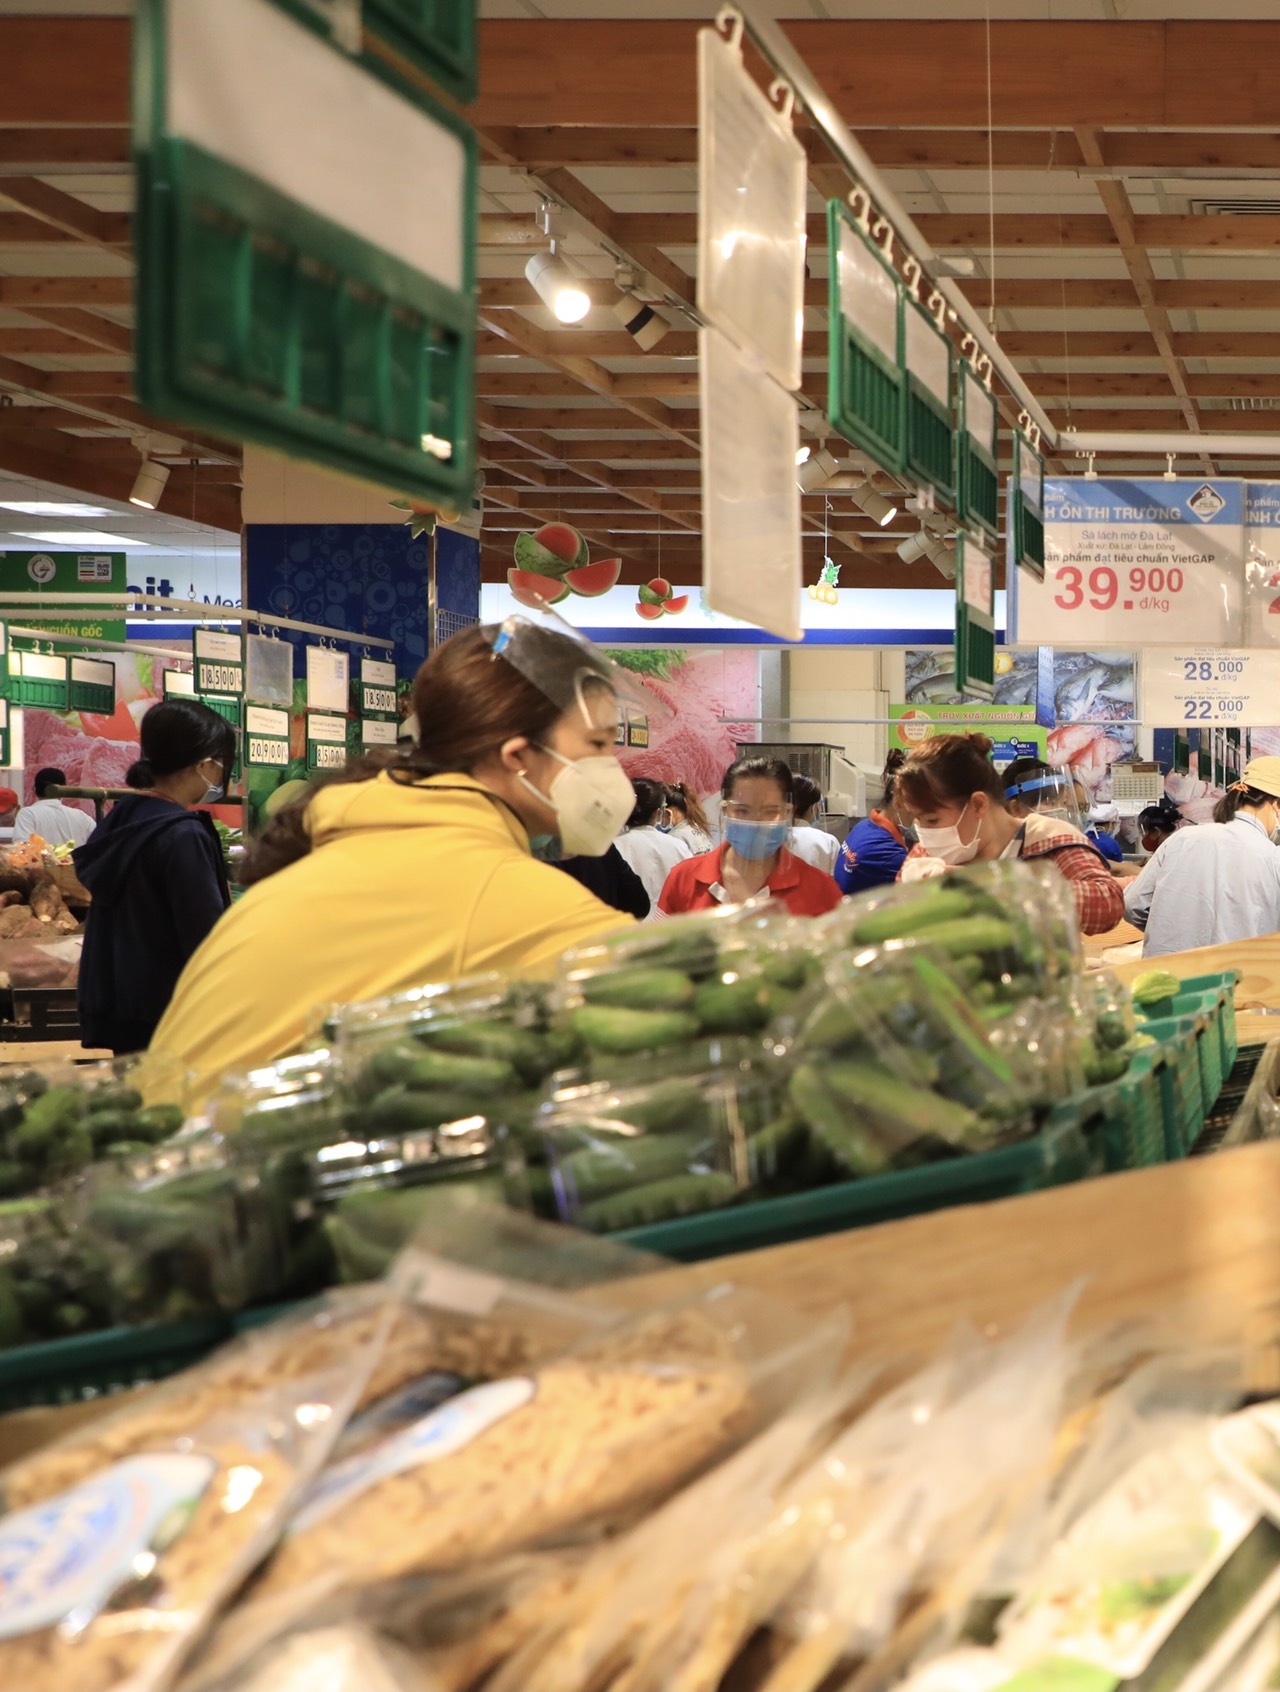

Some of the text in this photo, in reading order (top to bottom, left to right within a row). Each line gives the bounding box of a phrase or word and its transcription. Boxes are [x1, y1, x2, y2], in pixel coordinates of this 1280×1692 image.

[1059, 501, 1082, 519] ỔN
[1086, 506, 1110, 522] THỊ
[1114, 504, 1181, 520] TRƯỜNG
[1062, 552, 1092, 564] phẩm
[1114, 553, 1133, 563] tiêu
[1136, 552, 1169, 564] chuẩn
[1172, 554, 1215, 564] VietGAP
[81, 623, 103, 637] GỐC
